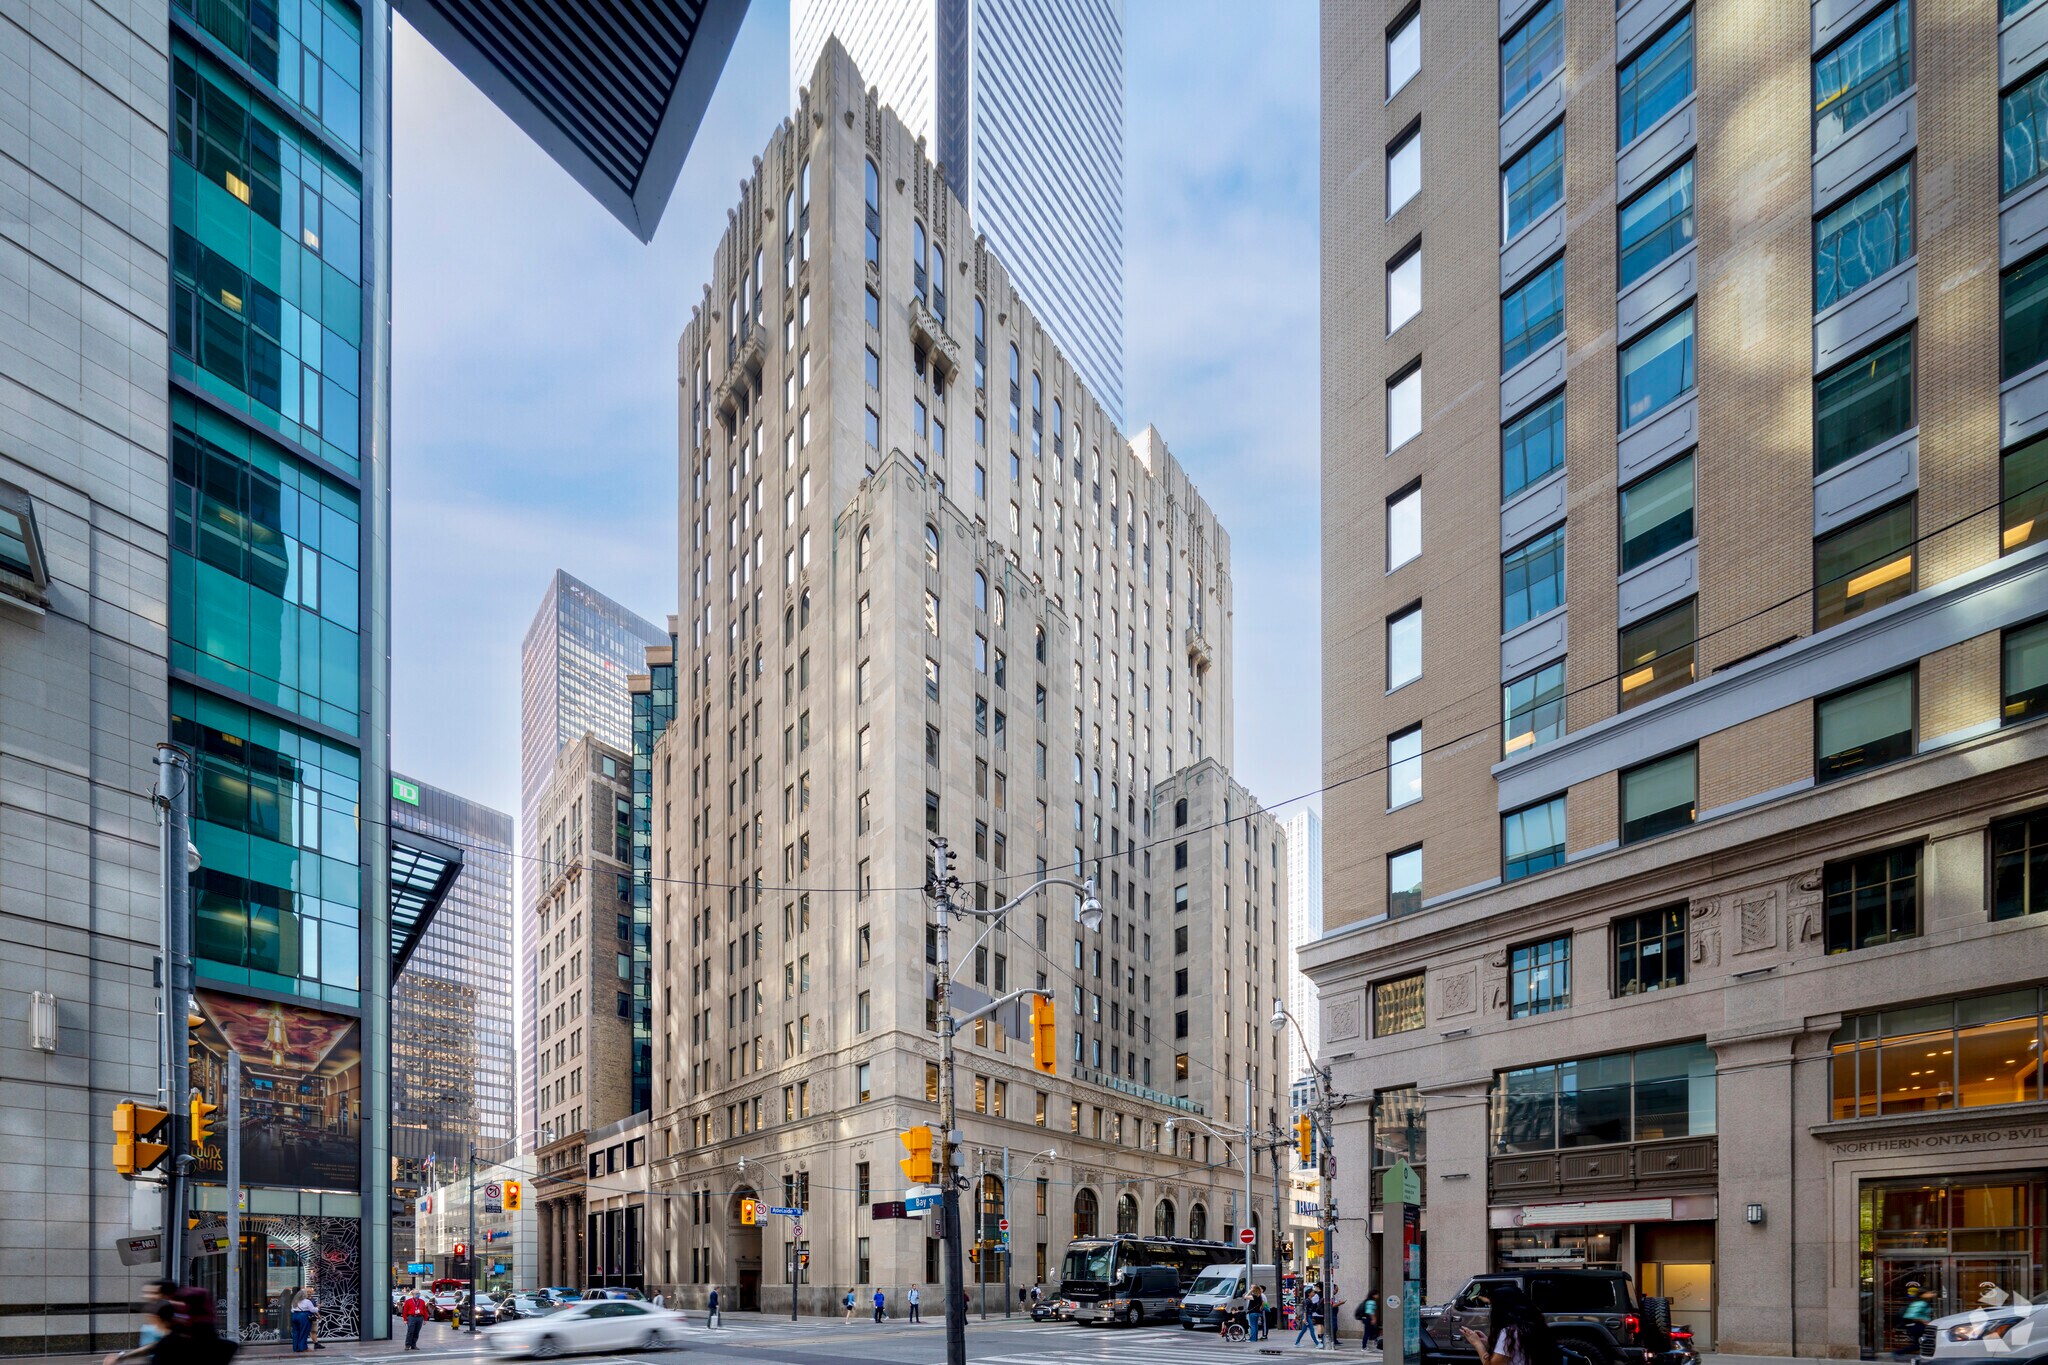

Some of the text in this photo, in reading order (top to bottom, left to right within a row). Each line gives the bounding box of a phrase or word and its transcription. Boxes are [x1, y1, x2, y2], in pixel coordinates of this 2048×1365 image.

[395, 781, 417, 801] TD
[1836, 1138, 1920, 1154] NORTHERN
[1925, 1131, 2000, 1147] ONTARIO
[915, 1198, 927, 1208] Bay
